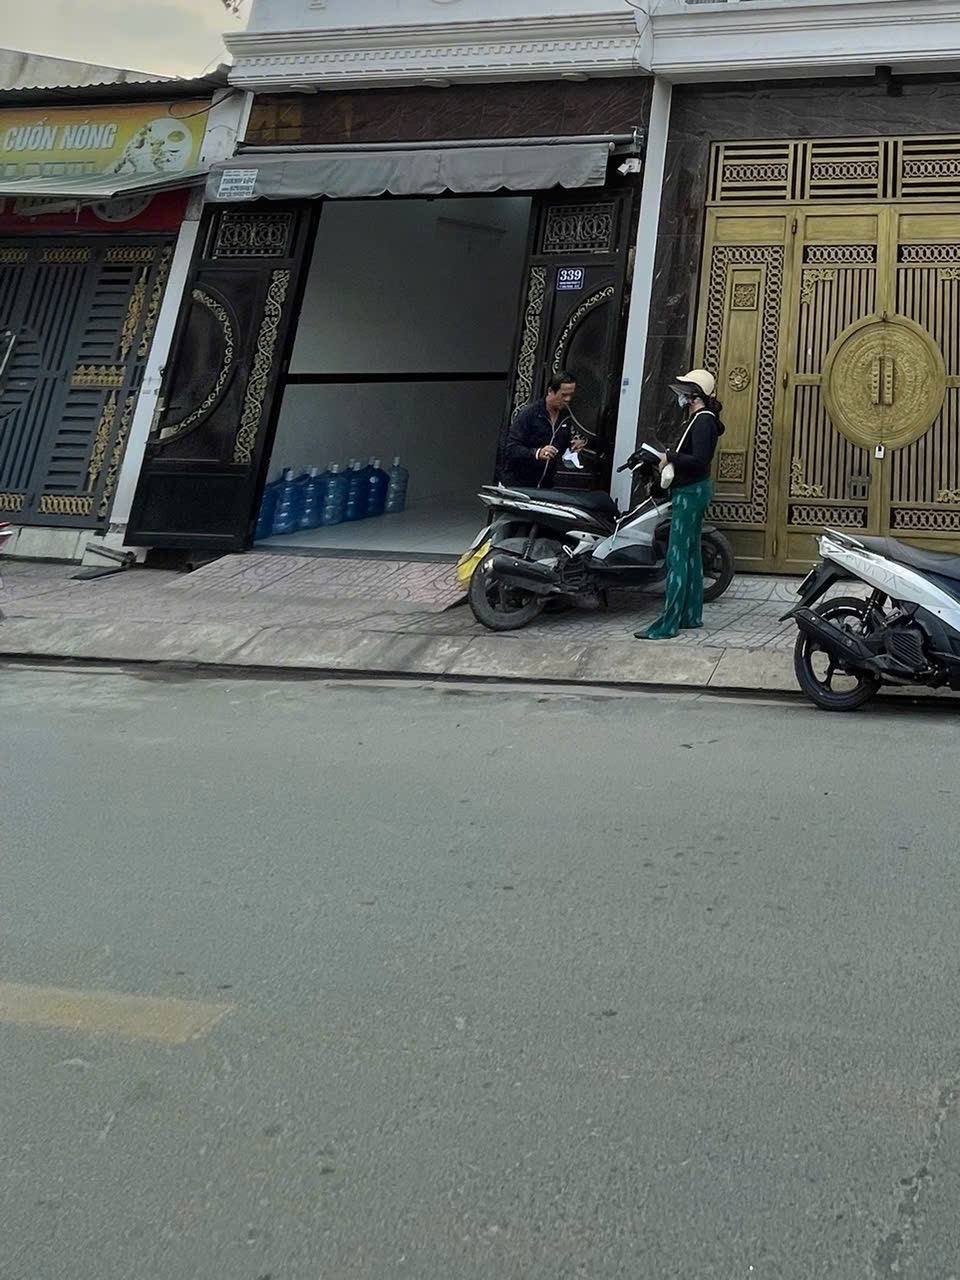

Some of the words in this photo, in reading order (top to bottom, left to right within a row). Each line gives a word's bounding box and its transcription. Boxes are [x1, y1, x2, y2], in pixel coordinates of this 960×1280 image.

[3, 116, 57, 152] CUỐN
[61, 119, 117, 150] NÓNG
[560, 269, 582, 281] 339
